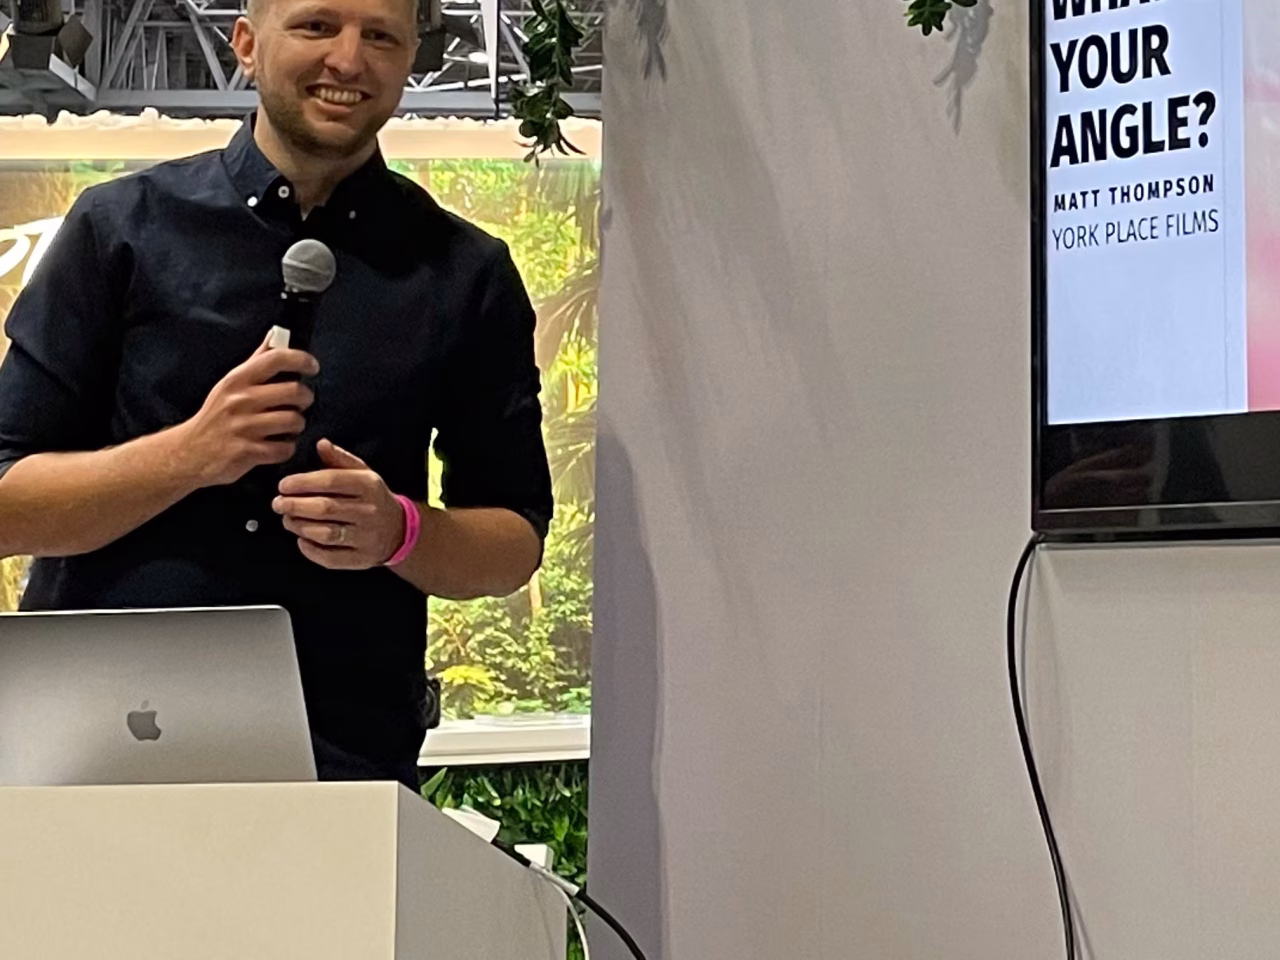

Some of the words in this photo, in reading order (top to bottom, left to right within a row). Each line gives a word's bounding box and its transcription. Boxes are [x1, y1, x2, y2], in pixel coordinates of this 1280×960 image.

[1049, 24, 1172, 93] YOUR
[1049, 90, 1217, 169] ANGLE?
[1053, 188, 1101, 213] MATT
[1109, 173, 1215, 206] THOMPSON
[1052, 224, 1100, 251] YORK
[1105, 215, 1160, 246] PLACE
[1166, 208, 1220, 238] FILMS
